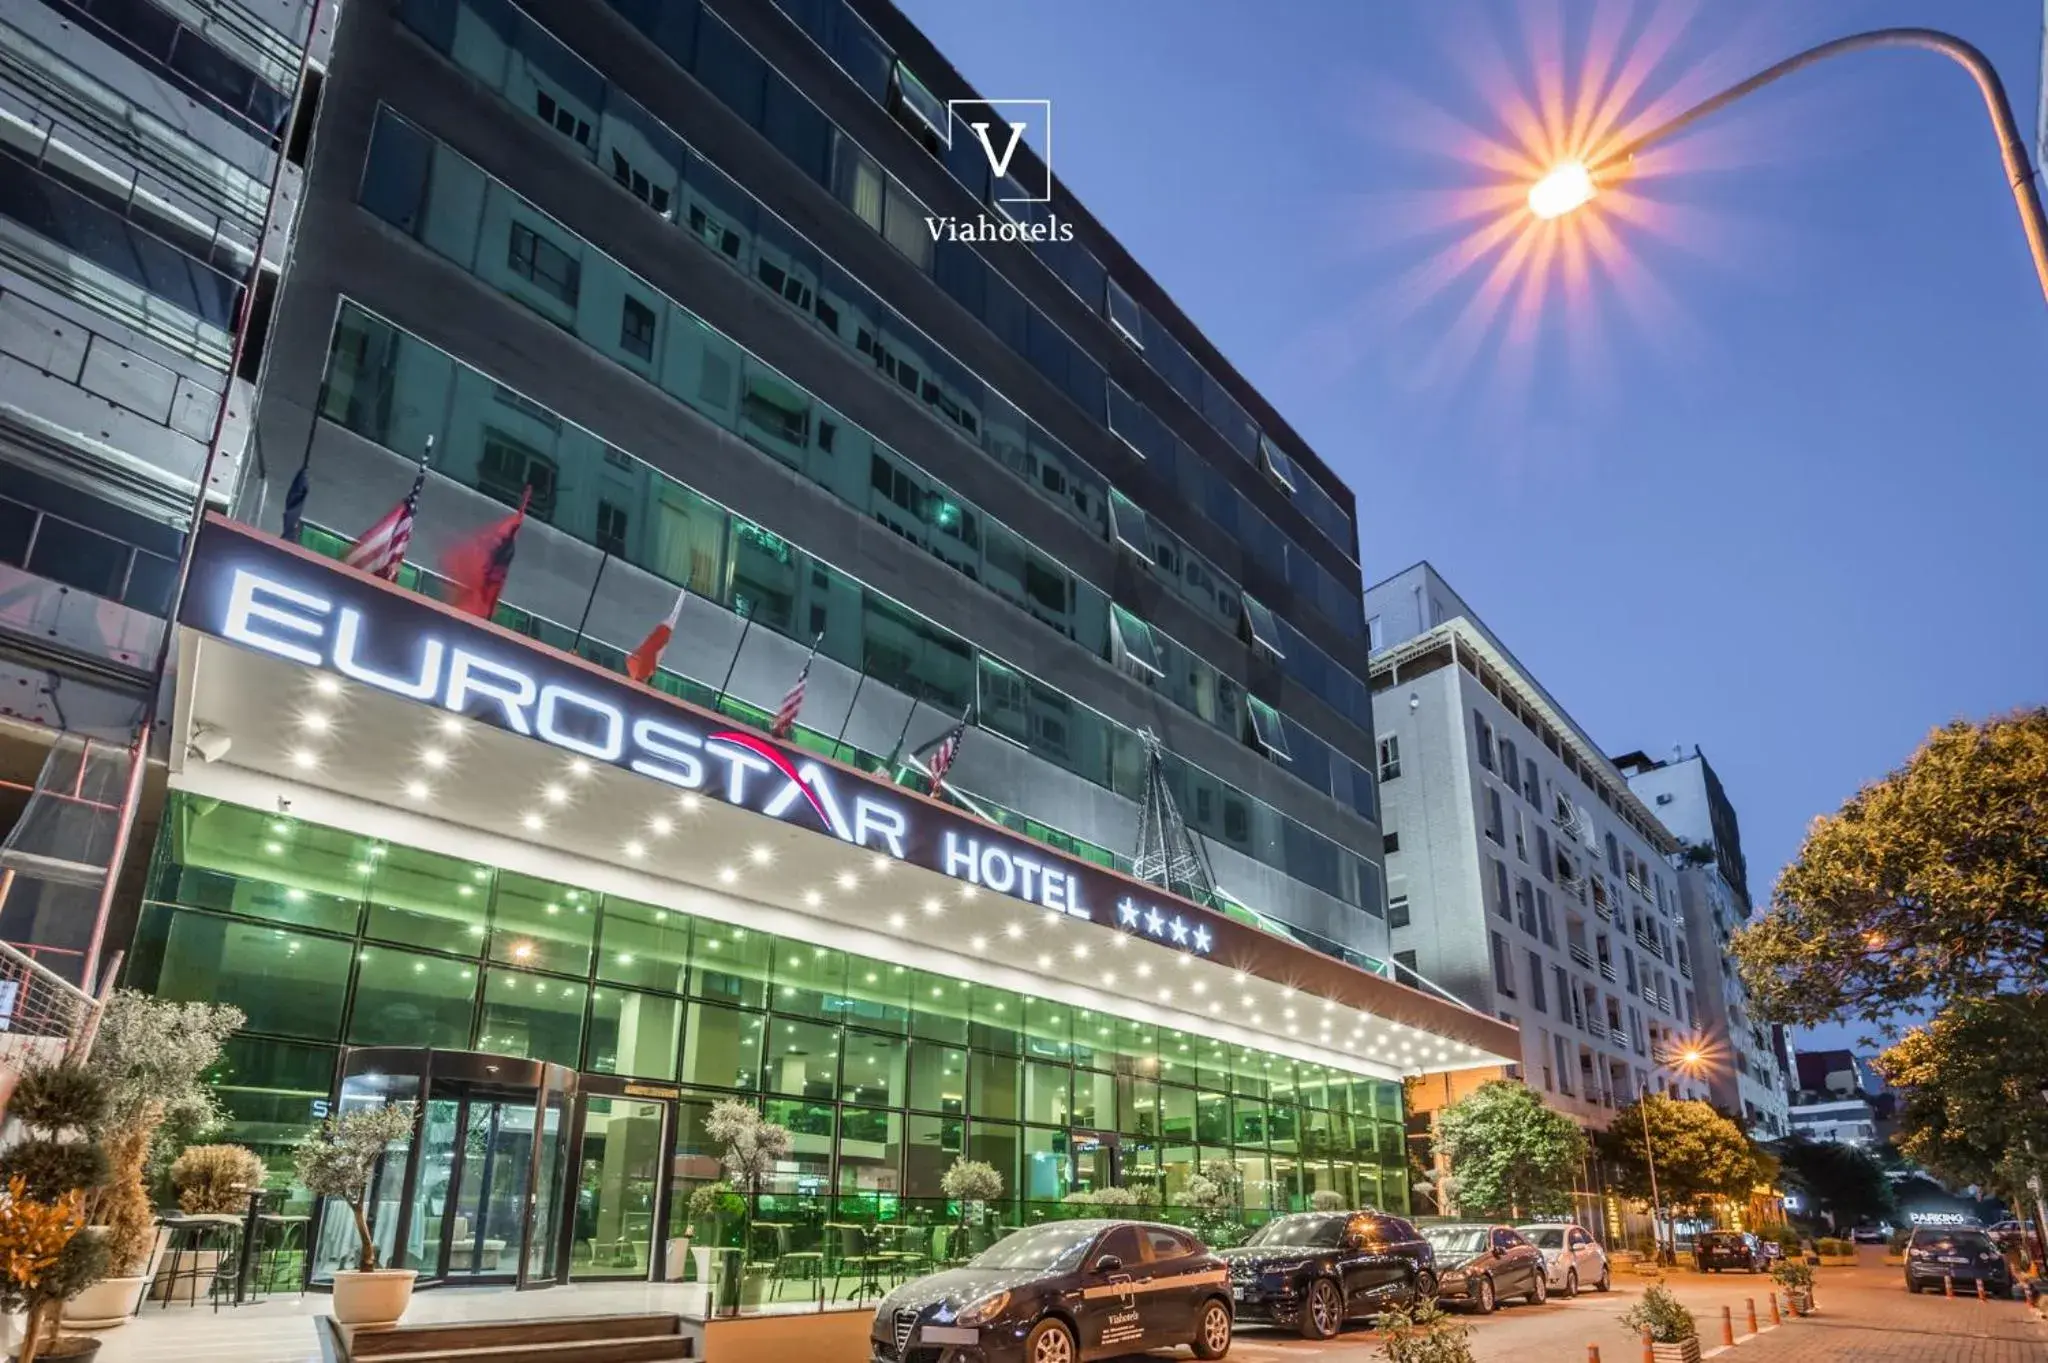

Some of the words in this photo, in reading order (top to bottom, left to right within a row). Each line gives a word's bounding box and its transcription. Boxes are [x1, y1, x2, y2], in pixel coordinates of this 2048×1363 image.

[221, 569, 906, 858] EUROSTAR
[944, 832, 1091, 920] HOTEL
[1909, 1212, 1964, 1225] PARKING
